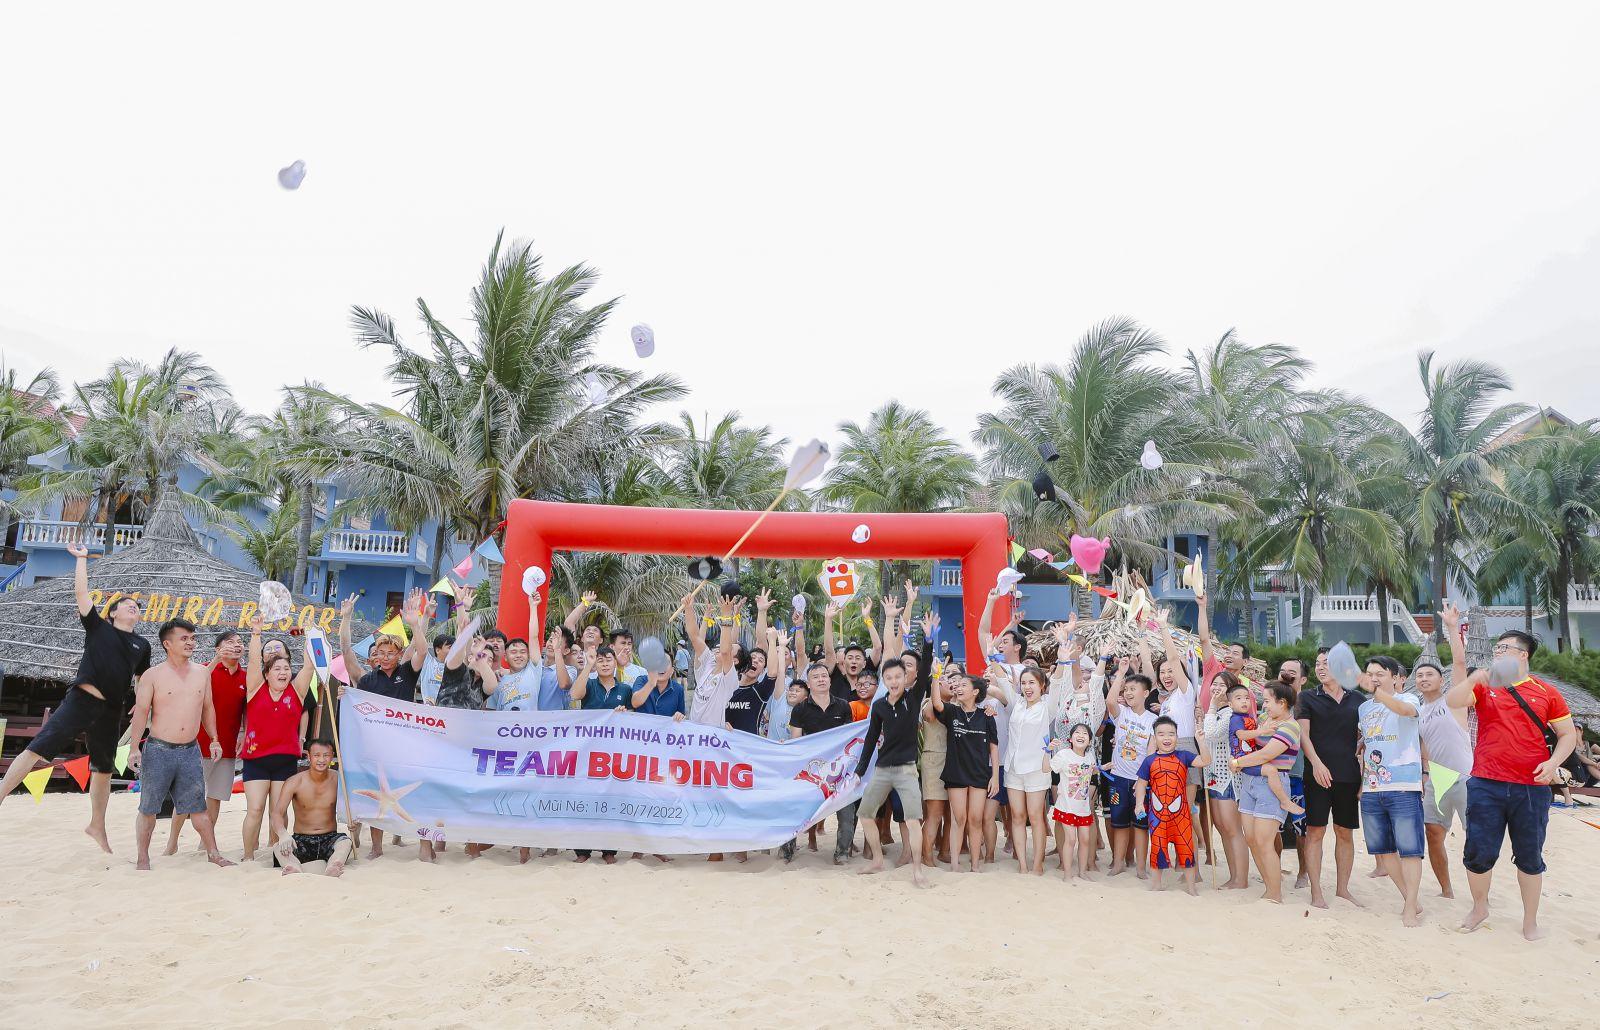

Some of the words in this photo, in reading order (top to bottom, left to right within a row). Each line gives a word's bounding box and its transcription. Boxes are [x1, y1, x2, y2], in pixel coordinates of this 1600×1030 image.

[497, 723, 548, 739] CÔNG
[552, 726, 570, 738] TY
[574, 725, 615, 739] TNHH
[619, 727, 662, 746] NHỰA
[665, 733, 695, 750] ĐẠT
[698, 732, 732, 751] HÒA
[471, 747, 579, 777] TEAM
[586, 751, 754, 790] BUILDING
[538, 798, 562, 813] Mũi
[565, 799, 589, 813] Né:
[594, 801, 608, 813] 18
[619, 802, 683, 819] 20/7/2022
